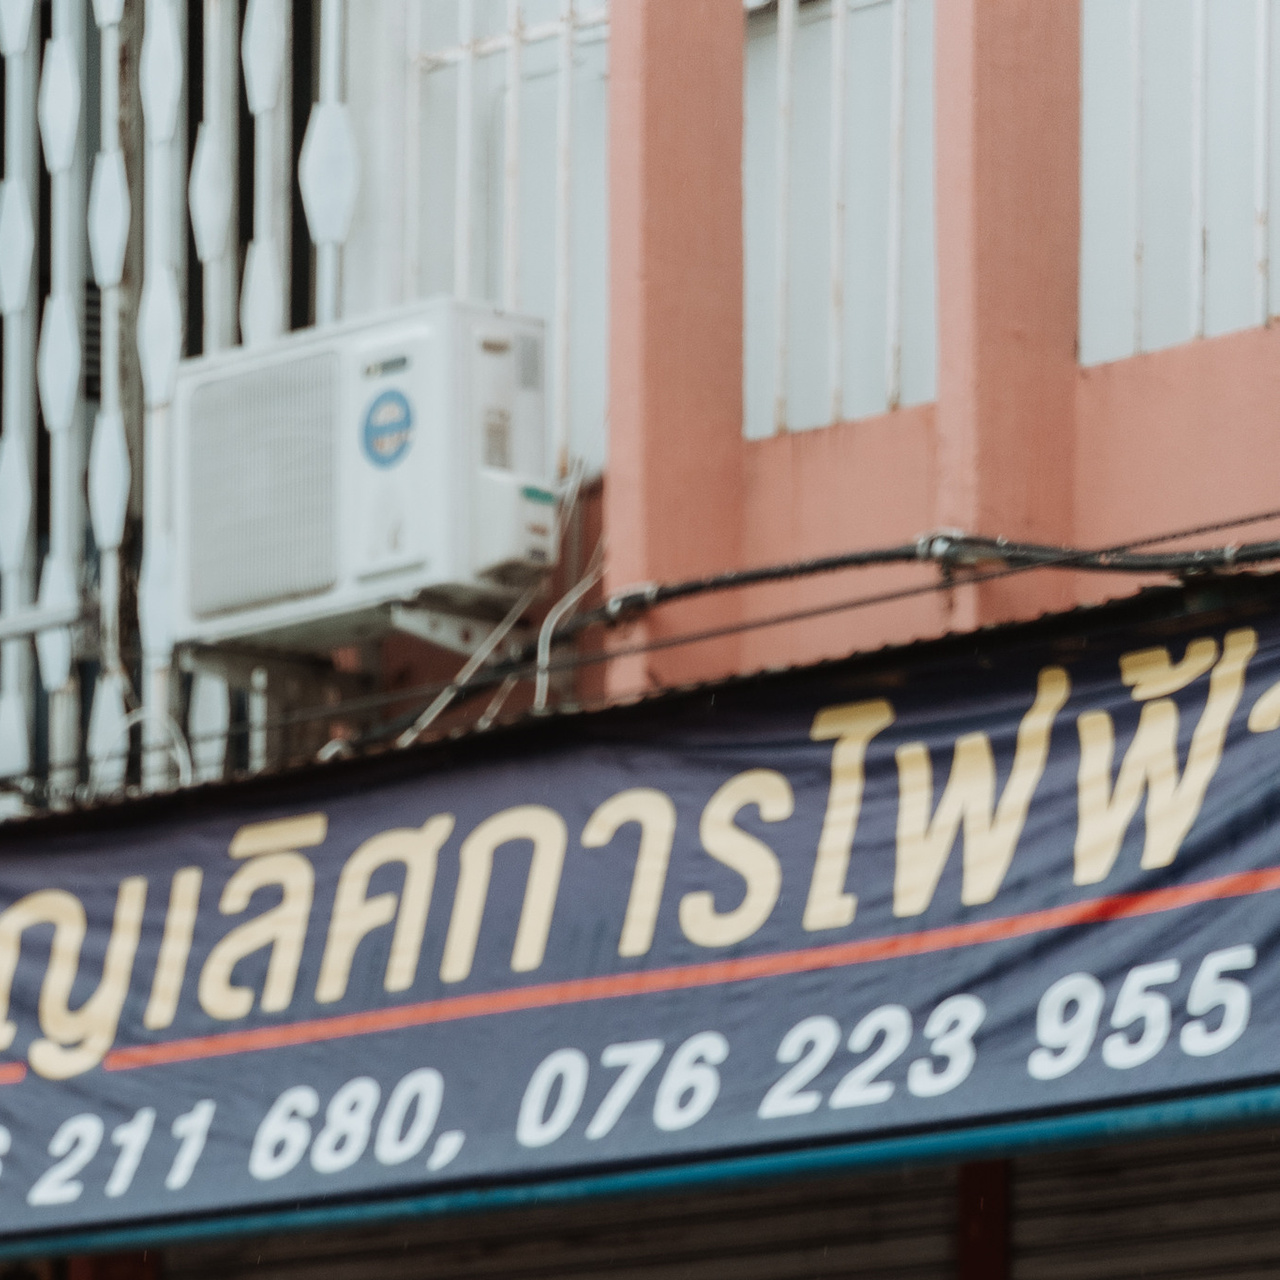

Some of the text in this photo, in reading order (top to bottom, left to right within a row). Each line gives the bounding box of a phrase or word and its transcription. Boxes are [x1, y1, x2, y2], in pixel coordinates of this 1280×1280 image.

[27, 1098, 218, 1207] 211
[248, 1066, 466, 1181] 680,
[515, 1030, 730, 1149] 076
[756, 993, 988, 1121] 223
[1026, 943, 1258, 1082] 955
